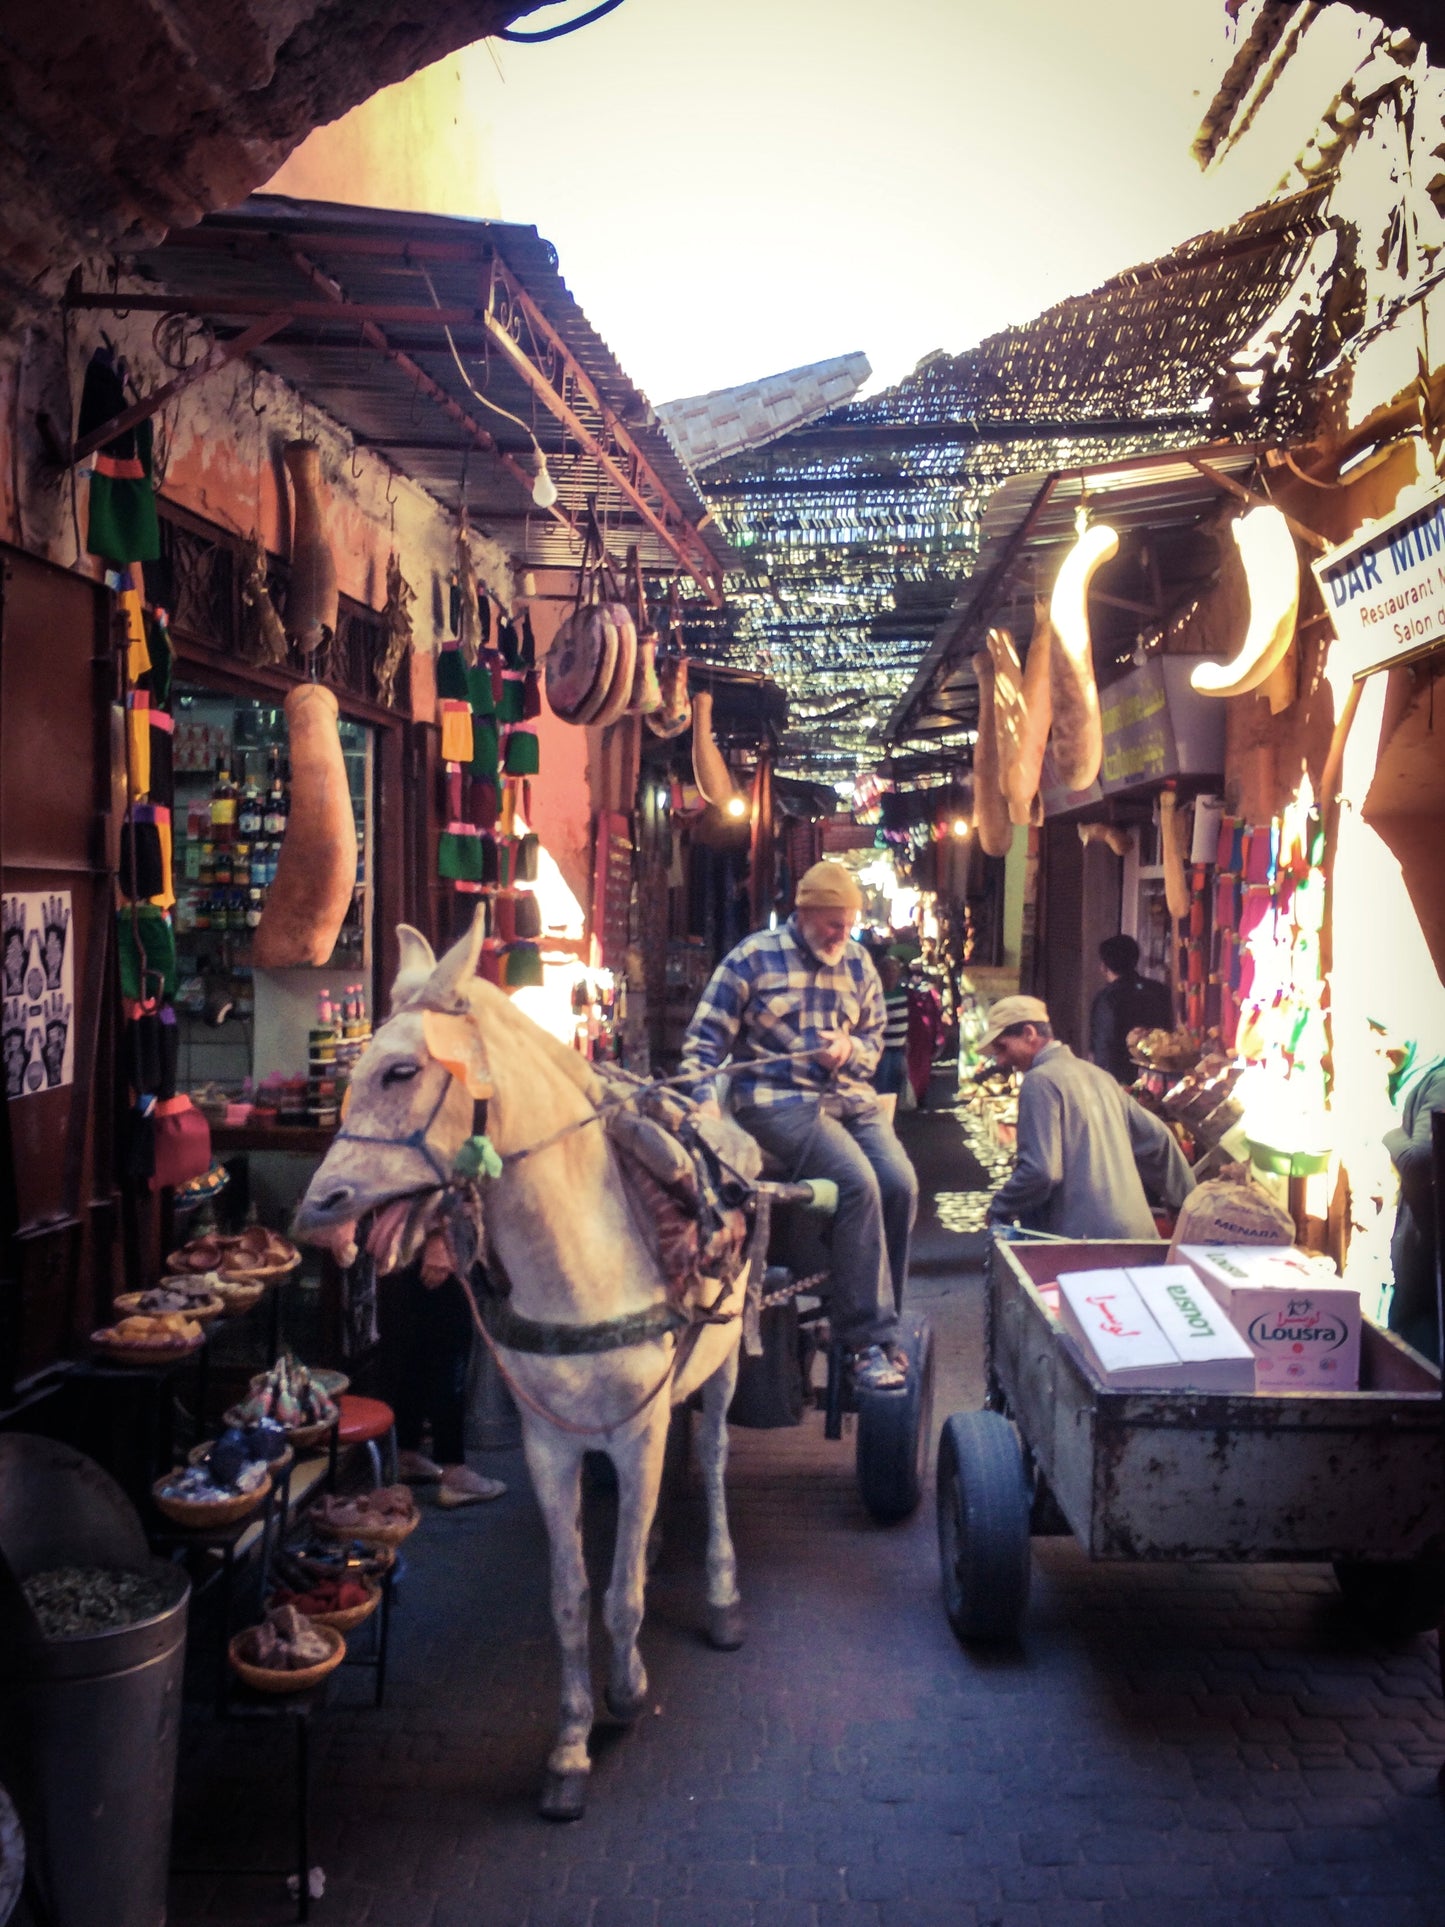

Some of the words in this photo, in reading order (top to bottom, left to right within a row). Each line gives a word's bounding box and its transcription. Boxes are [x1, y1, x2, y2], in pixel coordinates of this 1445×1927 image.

[1327, 545, 1383, 608] DAR
[1360, 577, 1434, 628] Restaurant
[1393, 614, 1433, 644] Salon
[1166, 1284, 1216, 1338] Lousra
[1260, 1322, 1337, 1341] Lousra
